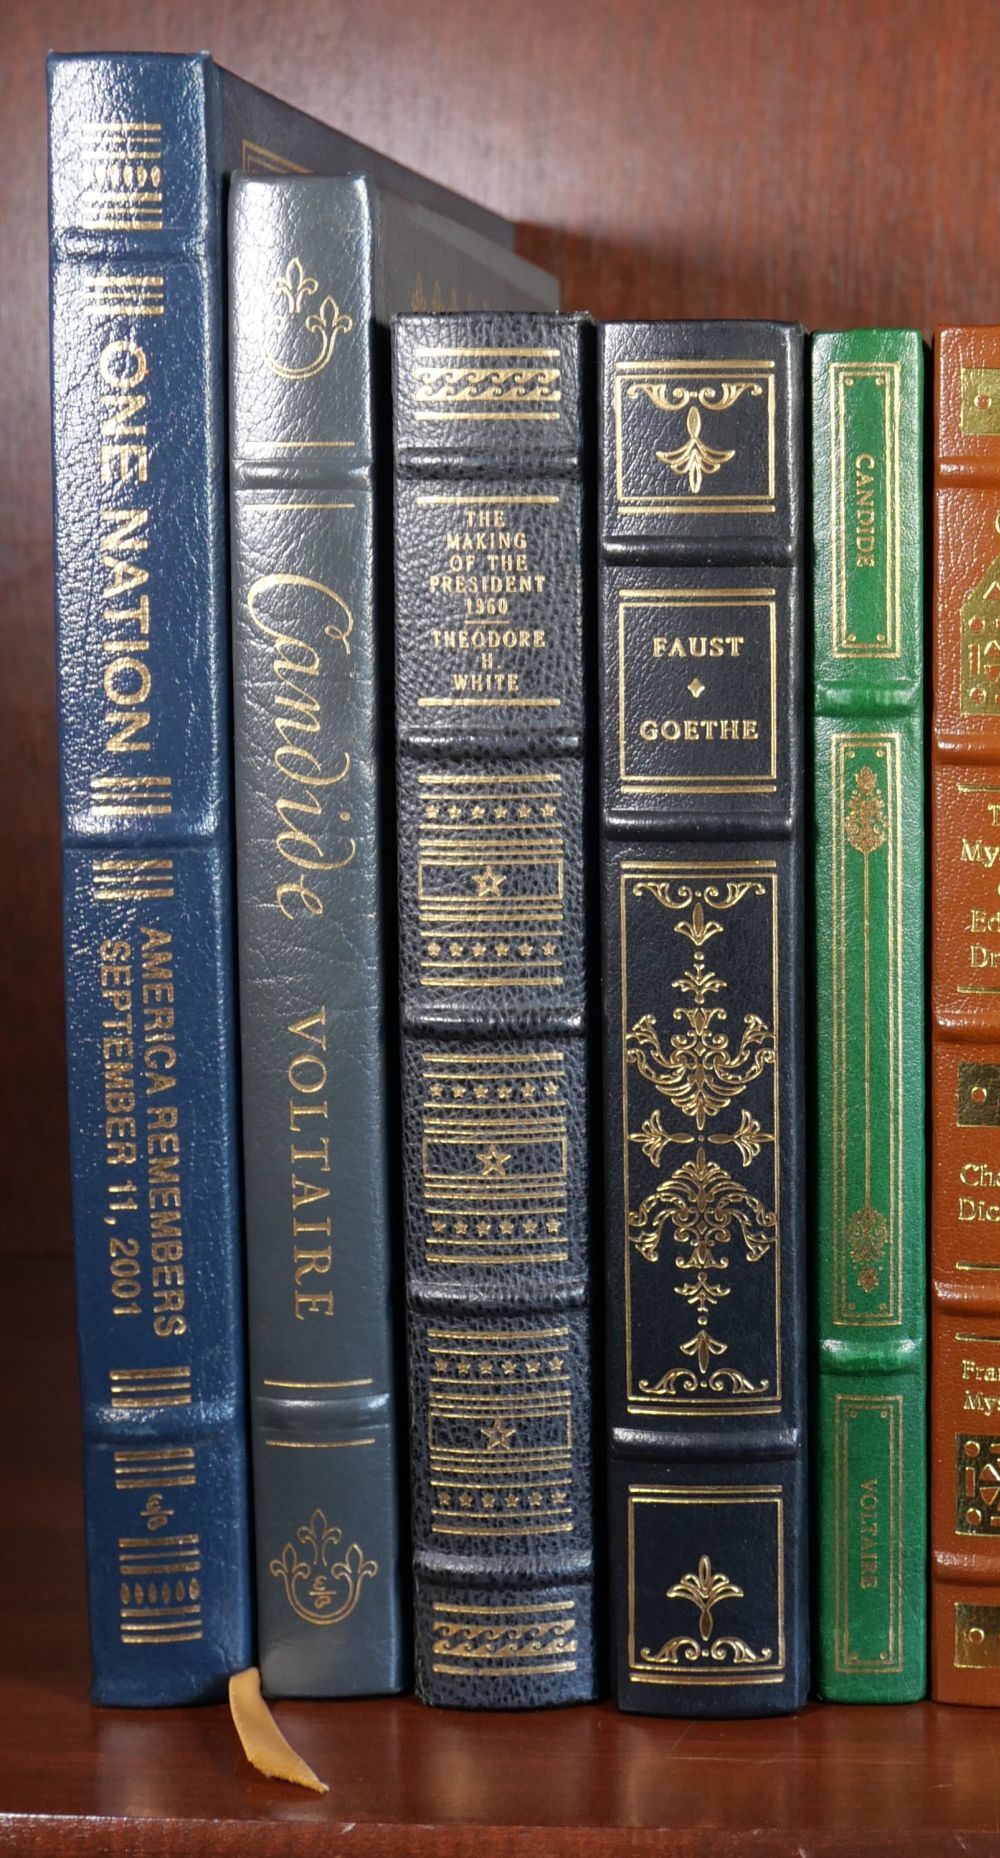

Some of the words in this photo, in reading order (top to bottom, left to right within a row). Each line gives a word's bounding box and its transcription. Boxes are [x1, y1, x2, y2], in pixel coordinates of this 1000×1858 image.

[99, 340, 149, 485] ONE
[446, 532, 527, 550] MAKING
[465, 510, 505, 528] THE
[855, 452, 875, 568] CANDIDE
[429, 575, 546, 594] PRESIDENT
[449, 554, 474, 573] OF
[487, 554, 528, 573] THE
[100, 509, 151, 753] NATION
[465, 598, 509, 615] 1960
[430, 630, 546, 649] THEODORE
[652, 636, 745, 657] FAUST
[453, 673, 519, 692] WHITE
[248, 572, 356, 921] Candide
[639, 719, 759, 740] GOETHE
[139, 926, 178, 1095] AMERICA
[100, 939, 137, 1165] SEPTEMBER
[285, 1006, 335, 1323] VOLTAIRE
[104, 1179, 138, 1226] 11,
[147, 1106, 187, 1337] REMEMBERS
[110, 1237, 142, 1315] 2001
[860, 1478, 878, 1589] VOLTAIRE
